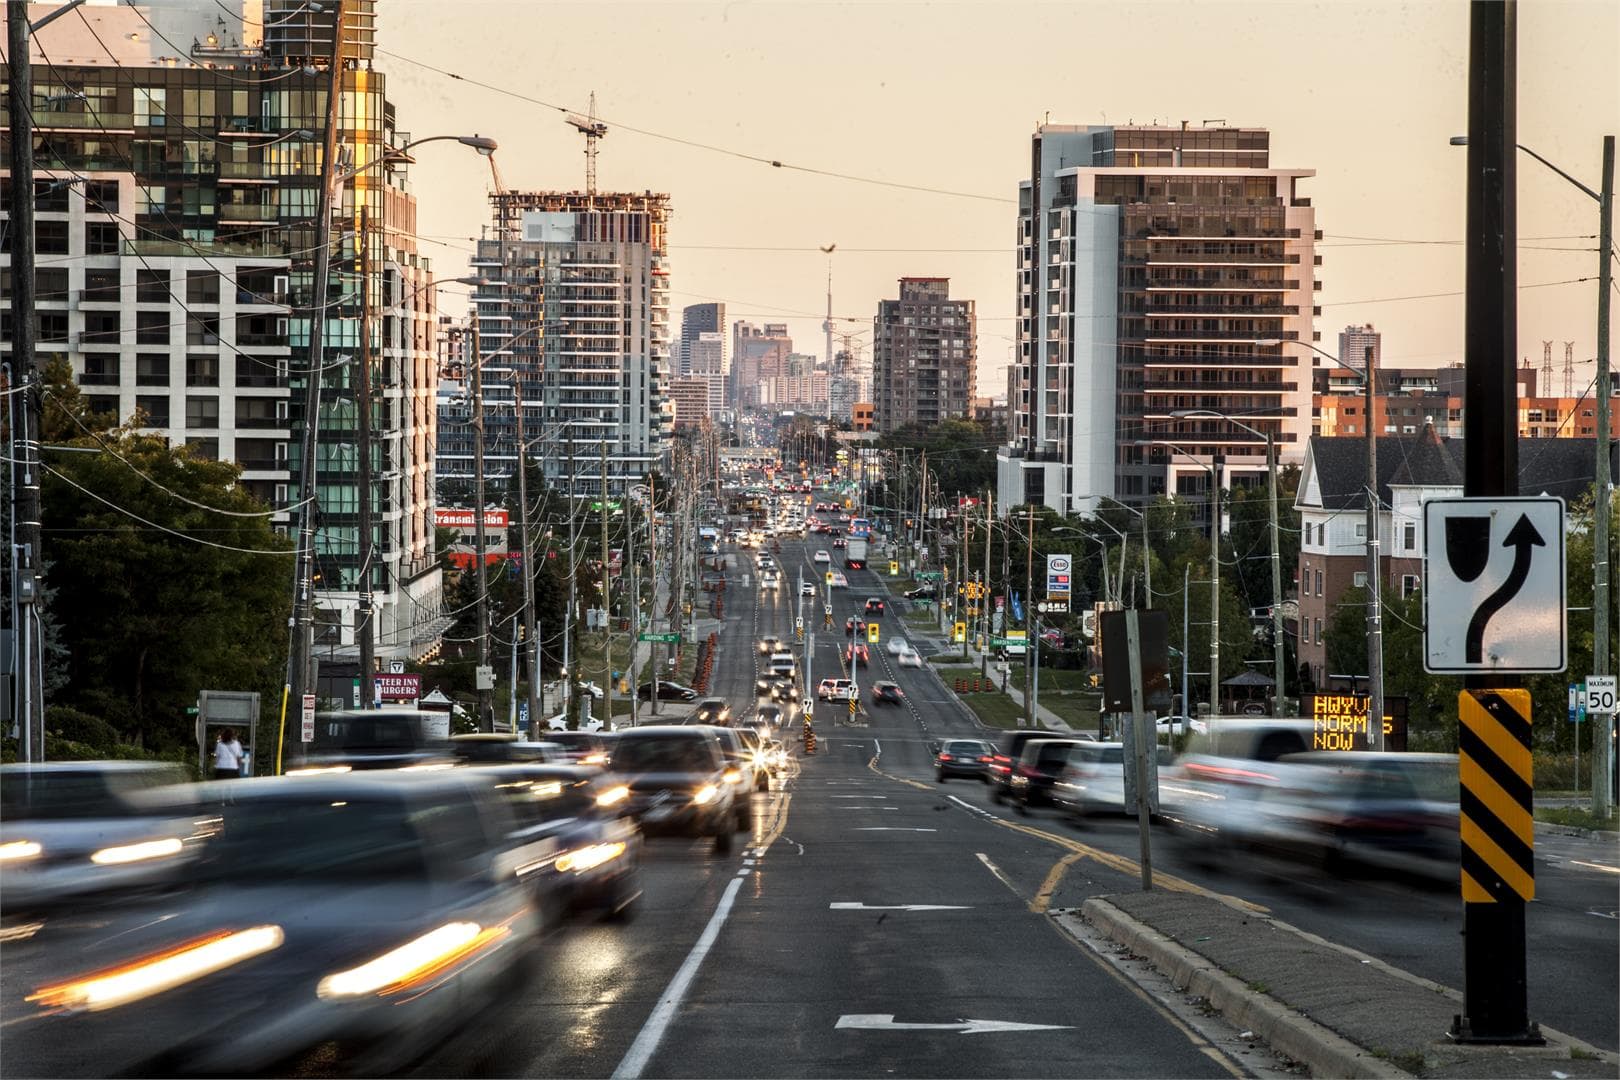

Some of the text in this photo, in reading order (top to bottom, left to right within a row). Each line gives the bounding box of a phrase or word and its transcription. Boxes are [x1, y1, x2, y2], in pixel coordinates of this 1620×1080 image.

[434, 513, 503, 524] transmiion
[377, 678, 402, 686] TEER
[379, 686, 417, 695] URGERS
[1590, 692, 1613, 708] 50
[1314, 733, 1353, 751] NOW
